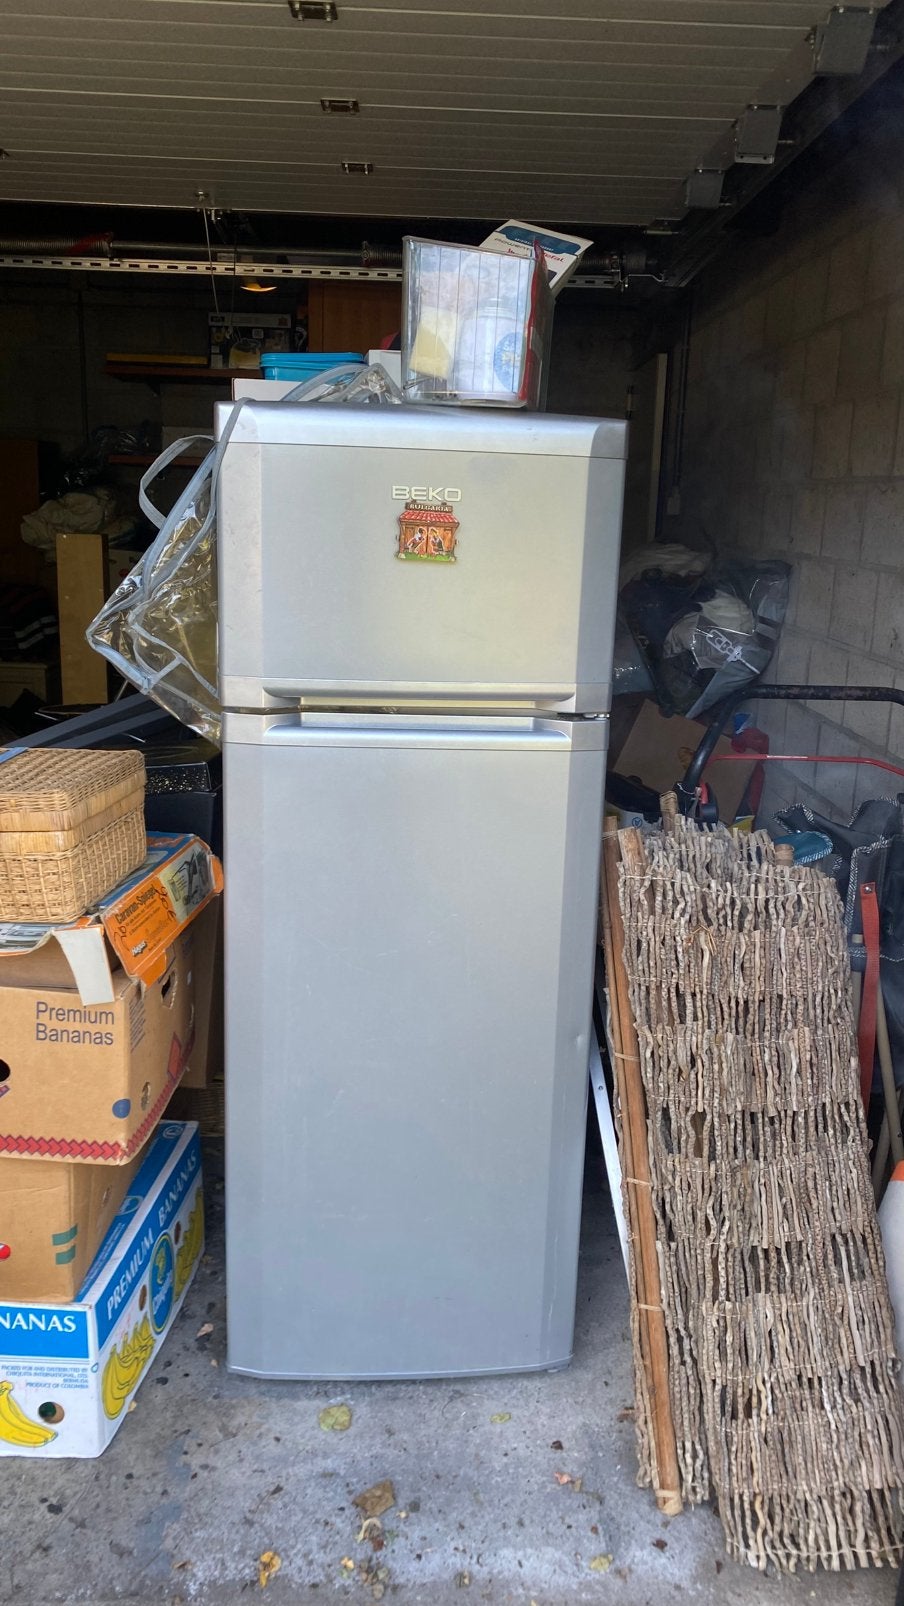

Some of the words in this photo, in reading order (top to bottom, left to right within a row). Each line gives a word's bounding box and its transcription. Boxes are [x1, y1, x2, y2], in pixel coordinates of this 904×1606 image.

[392, 485, 462, 502] BEKO
[409, 503, 449, 512] BULGARIA
[36, 1001, 115, 1025] Premium
[36, 1023, 114, 1045] Bananas
[106, 1227, 155, 1320] PREMIUM
[158, 1149, 197, 1226] BANANAS
